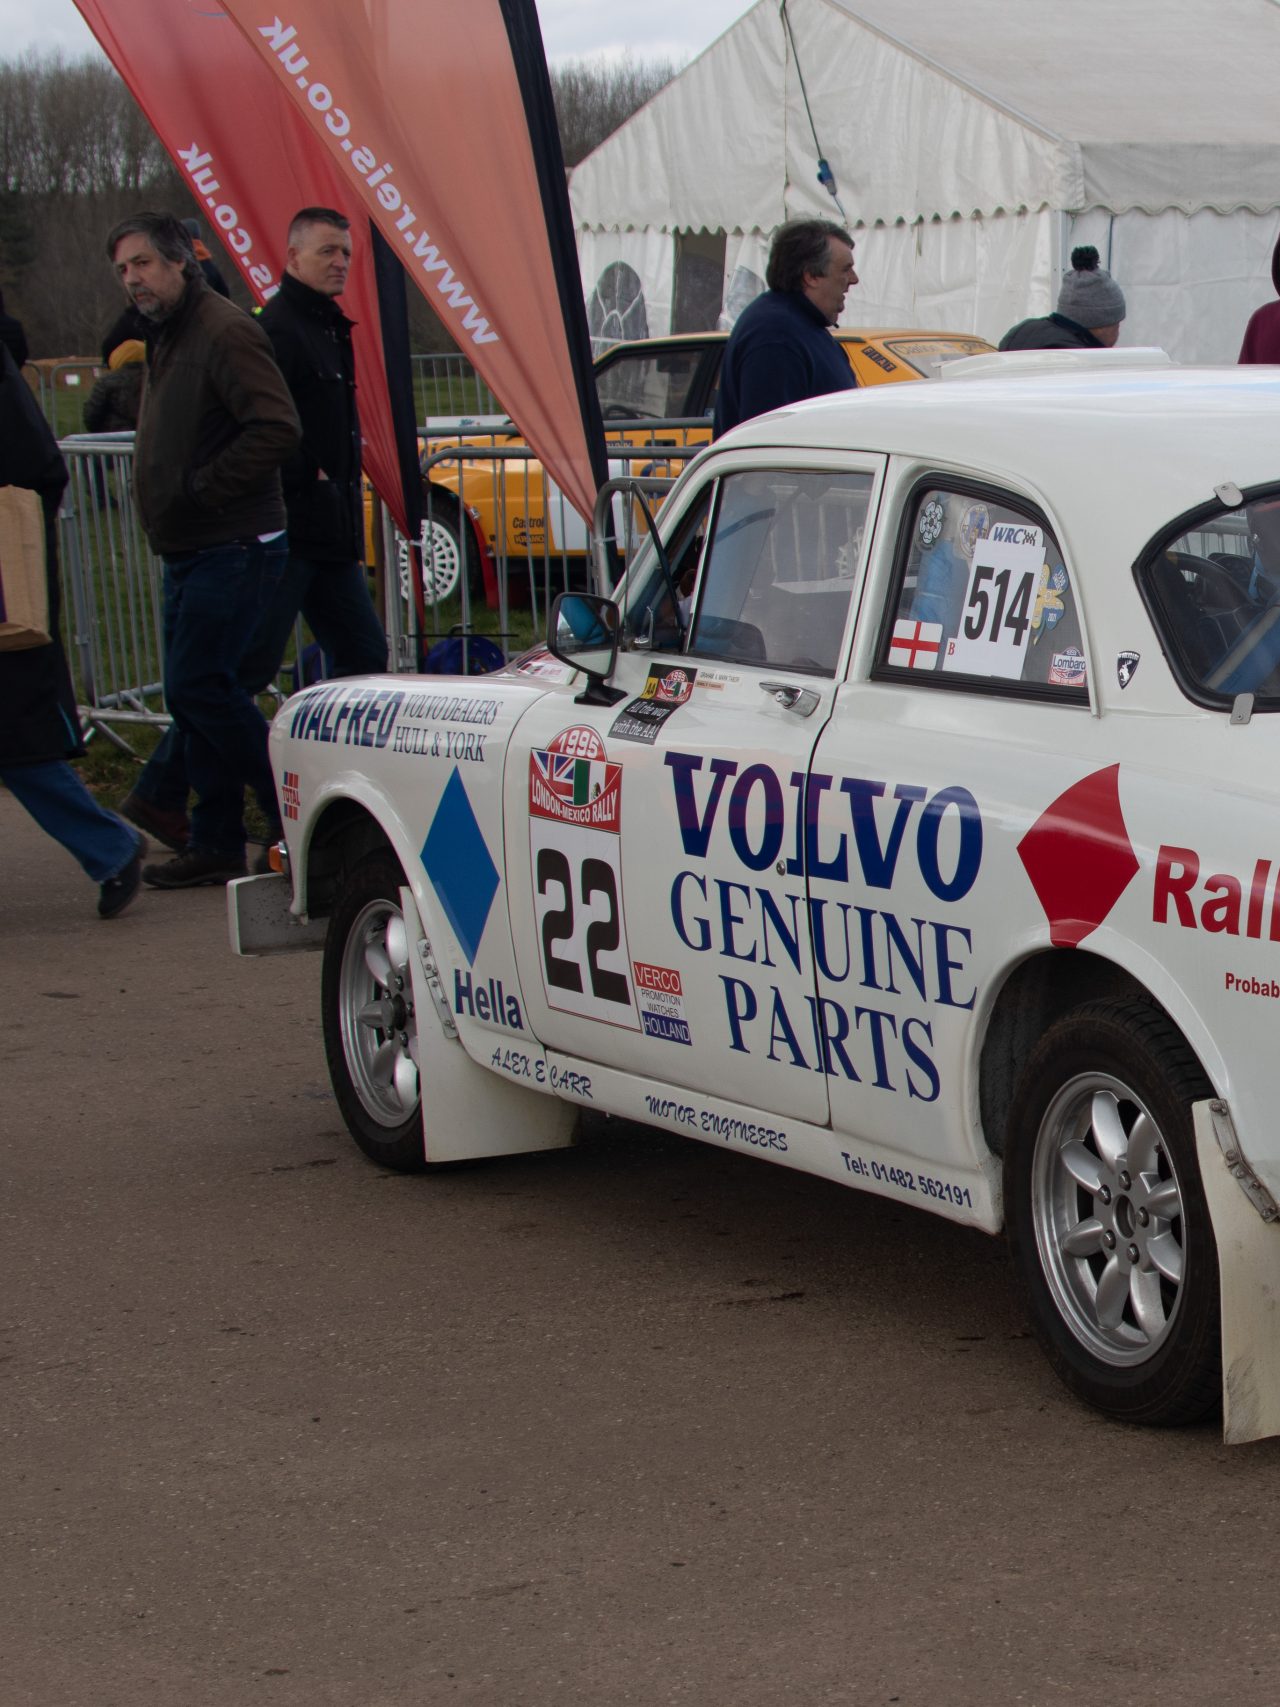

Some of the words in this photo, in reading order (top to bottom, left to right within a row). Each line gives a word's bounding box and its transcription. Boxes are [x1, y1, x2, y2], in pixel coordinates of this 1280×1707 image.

[513, 517, 544, 529] Catrol
[993, 526, 1024, 545] WRC
[964, 565, 1035, 647] 514
[948, 642, 955, 655] B
[290, 687, 406, 748] WALFRED
[403, 694, 453, 720] VOLVO
[444, 697, 503, 726] DEALERS
[612, 720, 629, 733] with
[630, 722, 641, 736] the
[627, 701, 641, 713] All
[641, 702, 653, 714] the
[653, 706, 670, 720] way
[393, 726, 428, 755] HULL
[431, 732, 441, 757] &
[446, 731, 487, 762] YORK
[558, 729, 600, 759] 1995
[282, 785, 301, 807] TOTAL
[532, 782, 591, 823] LONDON-MEXICO
[592, 788, 618, 823] RALLY
[664, 751, 983, 902] VOLVO
[537, 848, 631, 1006] 22
[670, 870, 978, 1012] GENUINE
[634, 963, 681, 991] VERCO
[455, 968, 524, 1030] Hella
[641, 988, 681, 1006] PROMOTION
[647, 1001, 679, 1018] WATCHES
[643, 1012, 692, 1042] HOLLAND
[718, 974, 941, 1102] PARTS
[491, 1047, 532, 1077] ALEX
[550, 1064, 593, 1099] CARR
[645, 1094, 698, 1127] MOTOR
[700, 1111, 788, 1152] ENGINEERS
[841, 1151, 869, 1177] Tel:
[871, 1161, 917, 1191] 01482
[918, 1174, 973, 1208] 562191
